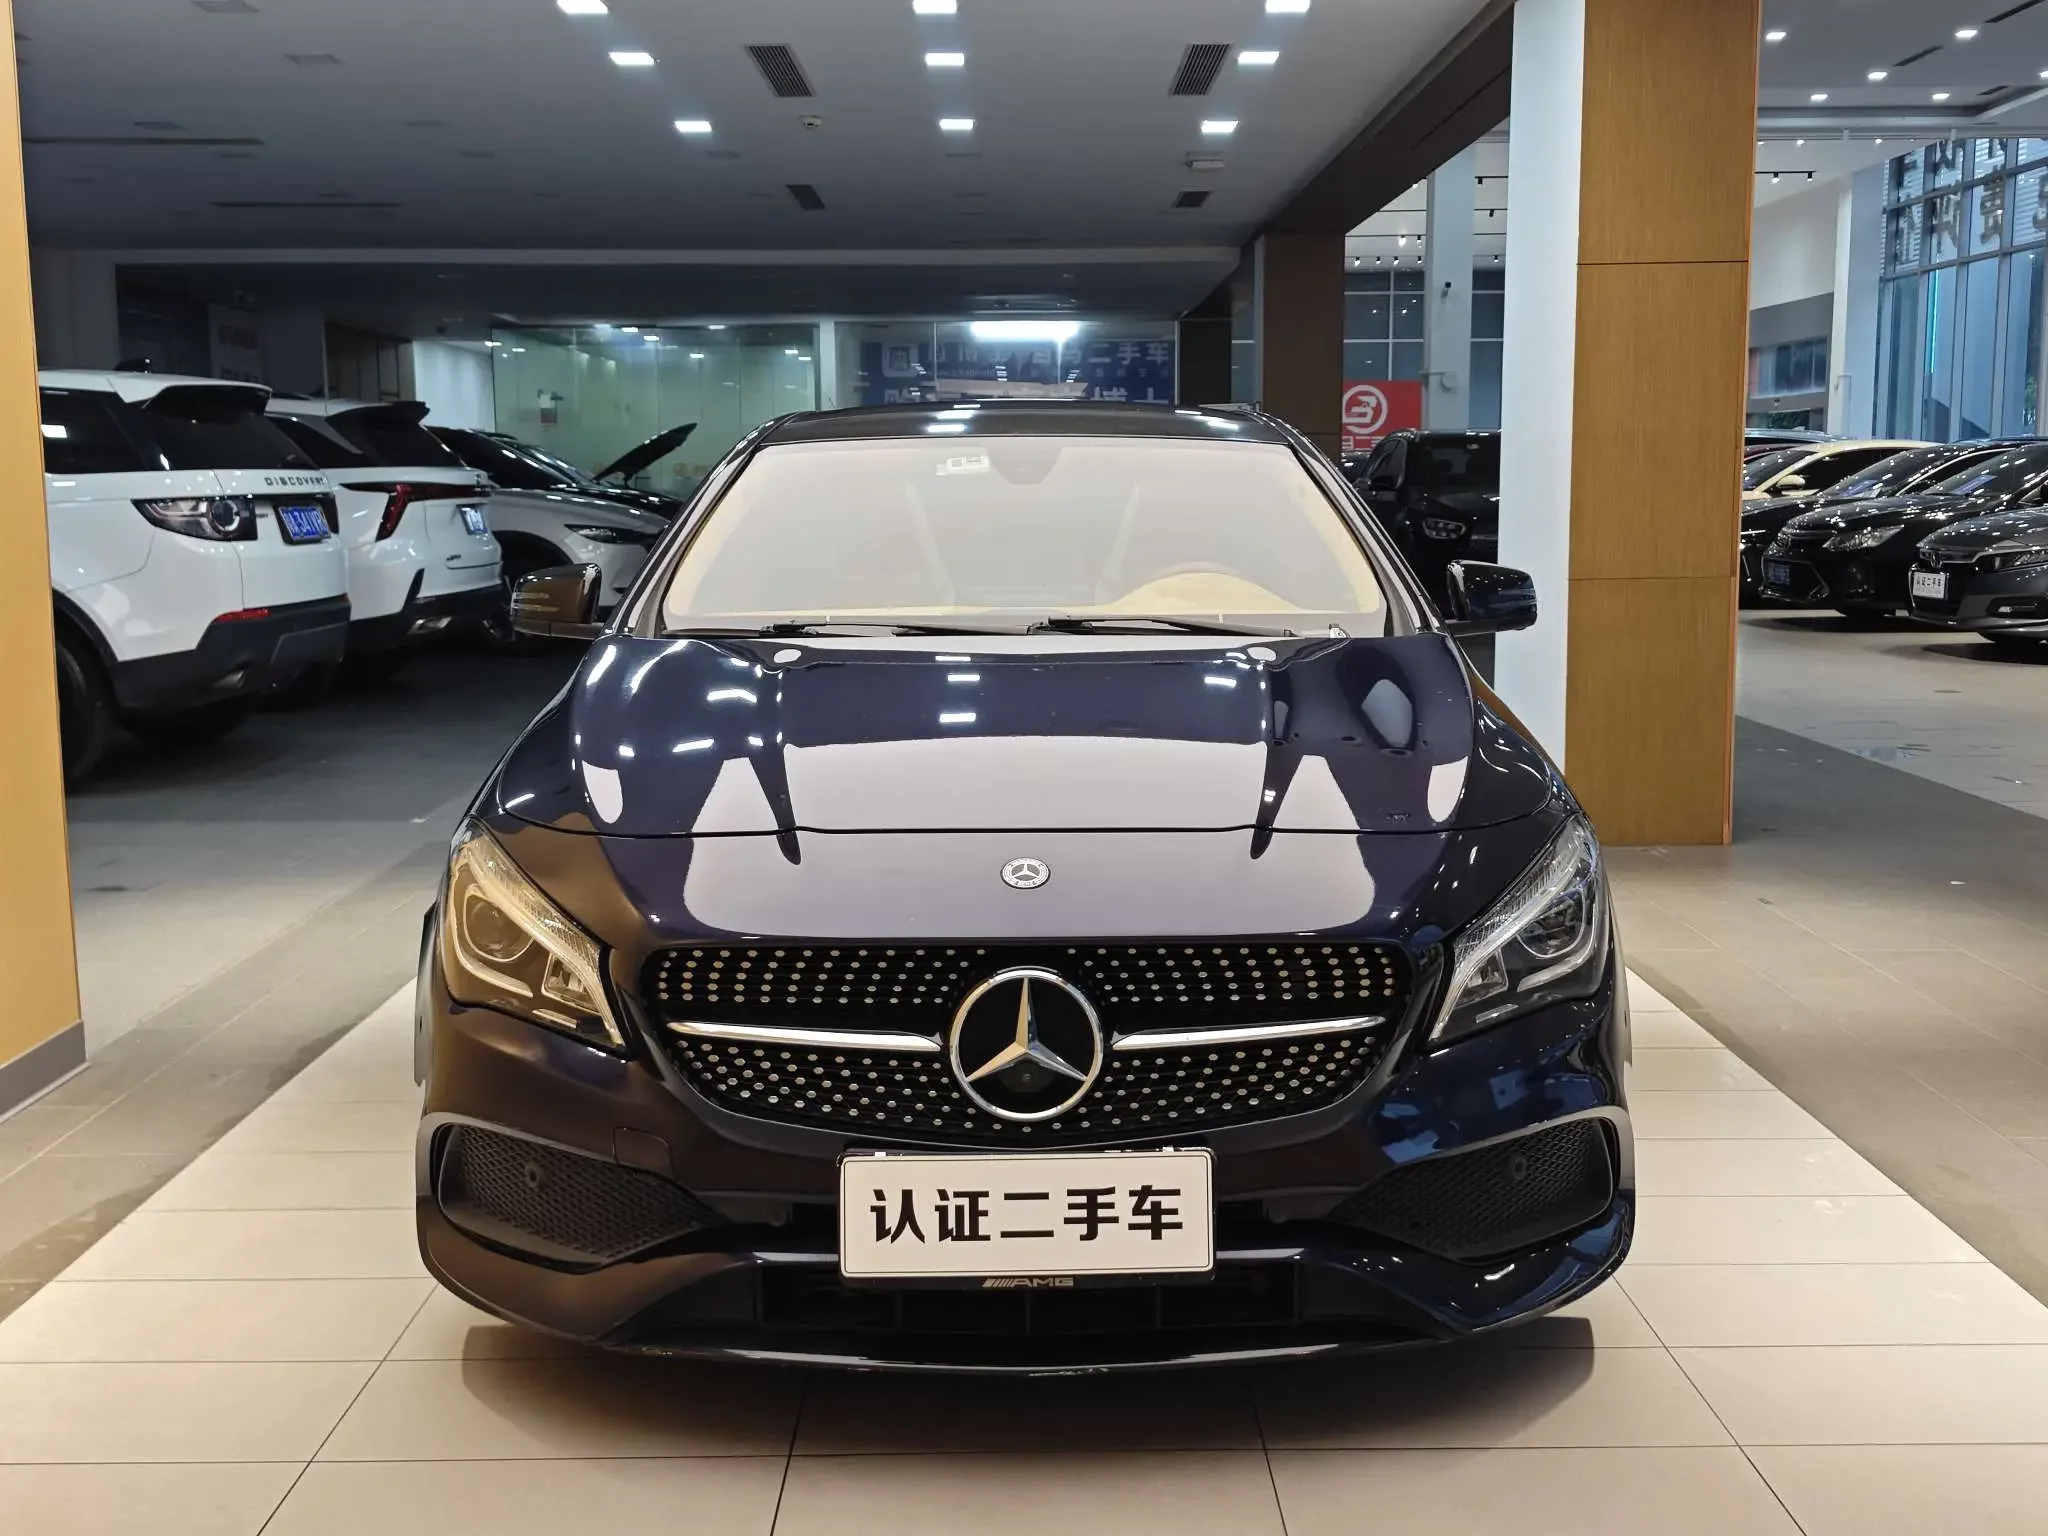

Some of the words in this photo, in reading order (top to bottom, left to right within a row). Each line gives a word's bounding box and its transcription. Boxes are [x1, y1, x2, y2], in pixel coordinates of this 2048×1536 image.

[870, 1184, 1183, 1244] 认证二手车
[1010, 1277, 1074, 1288] AMG
